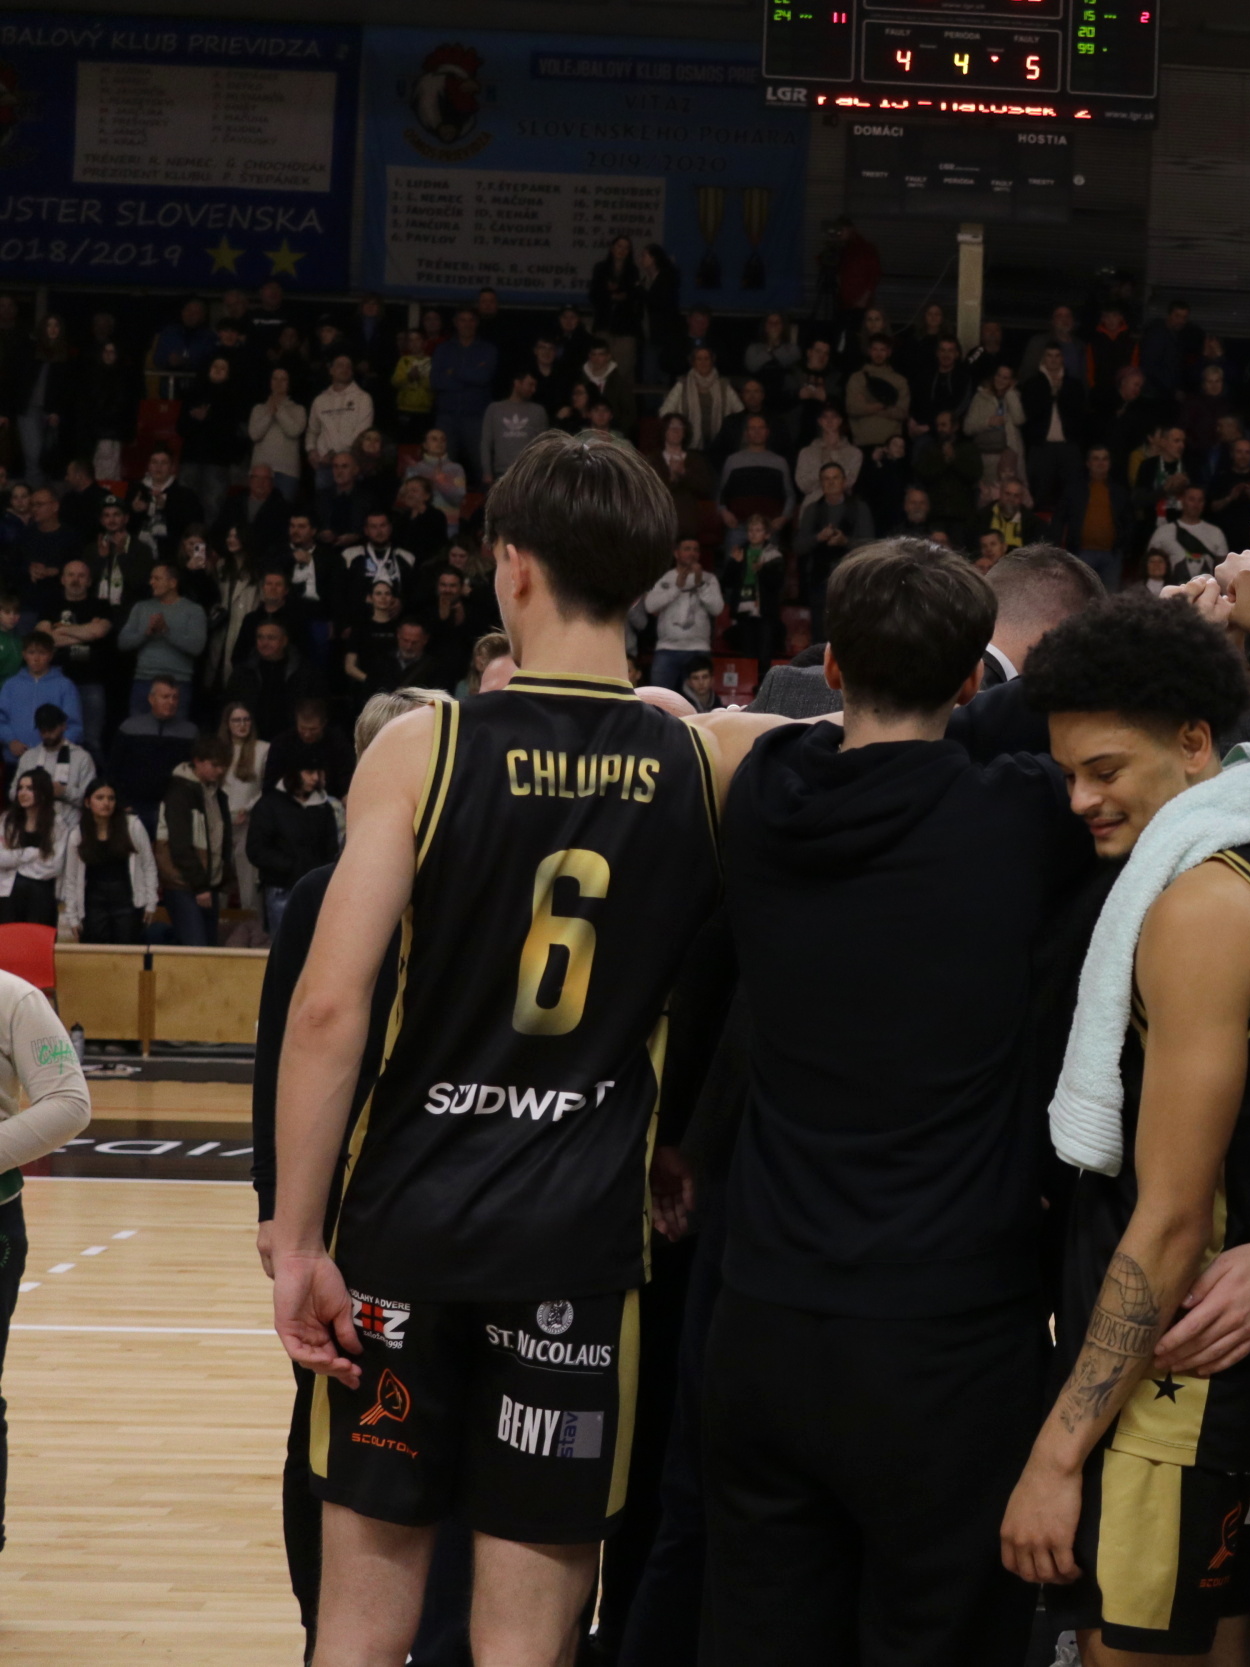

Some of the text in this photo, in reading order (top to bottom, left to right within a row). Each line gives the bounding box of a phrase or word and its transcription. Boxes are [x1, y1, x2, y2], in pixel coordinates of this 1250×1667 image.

[773, 9, 792, 21] 24
[833, 11, 847, 24] 11
[1083, 10, 1096, 21] 15
[1139, 11, 1151, 24] 2
[884, 27, 912, 37] FAULY
[1013, 34, 1040, 44] FAULY
[1077, 26, 1096, 38] 20
[111, 31, 178, 52] KLUB
[188, 34, 321, 58] PRIEVIDZA
[1077, 42, 1095, 55] 99
[538, 57, 633, 78] VOLEJBALOVÝ
[636, 61, 672, 79] KLUB
[675, 63, 724, 82] OSMOS
[895, 50, 1041, 80] 4 4 5
[766, 86, 807, 103] LGR
[854, 124, 904, 138] DOMÁCI
[1018, 133, 1067, 146] HOSTIA
[585, 151, 728, 173] 2019/2020
[595, 184, 662, 197] PORUBSKÝ
[420, 194, 464, 205] NEMEC
[116, 201, 324, 235] SLOVENSKA
[611, 213, 655, 225] KUDRA
[405, 233, 457, 245] PAVLOV
[609, 227, 653, 238] KUDRA
[1, 237, 183, 267] 018/2019
[478, 262, 505, 272] ING.
[527, 263, 578, 275] CHUDÍK
[416, 271, 492, 286] PREZIDENT
[506, 749, 661, 804] CHLUPIS
[512, 848, 611, 1035] 6
[485, 1324, 612, 1368] ST. NICOLAUS
[497, 1394, 561, 1458] BENY
[558, 1411, 579, 1459] stav
